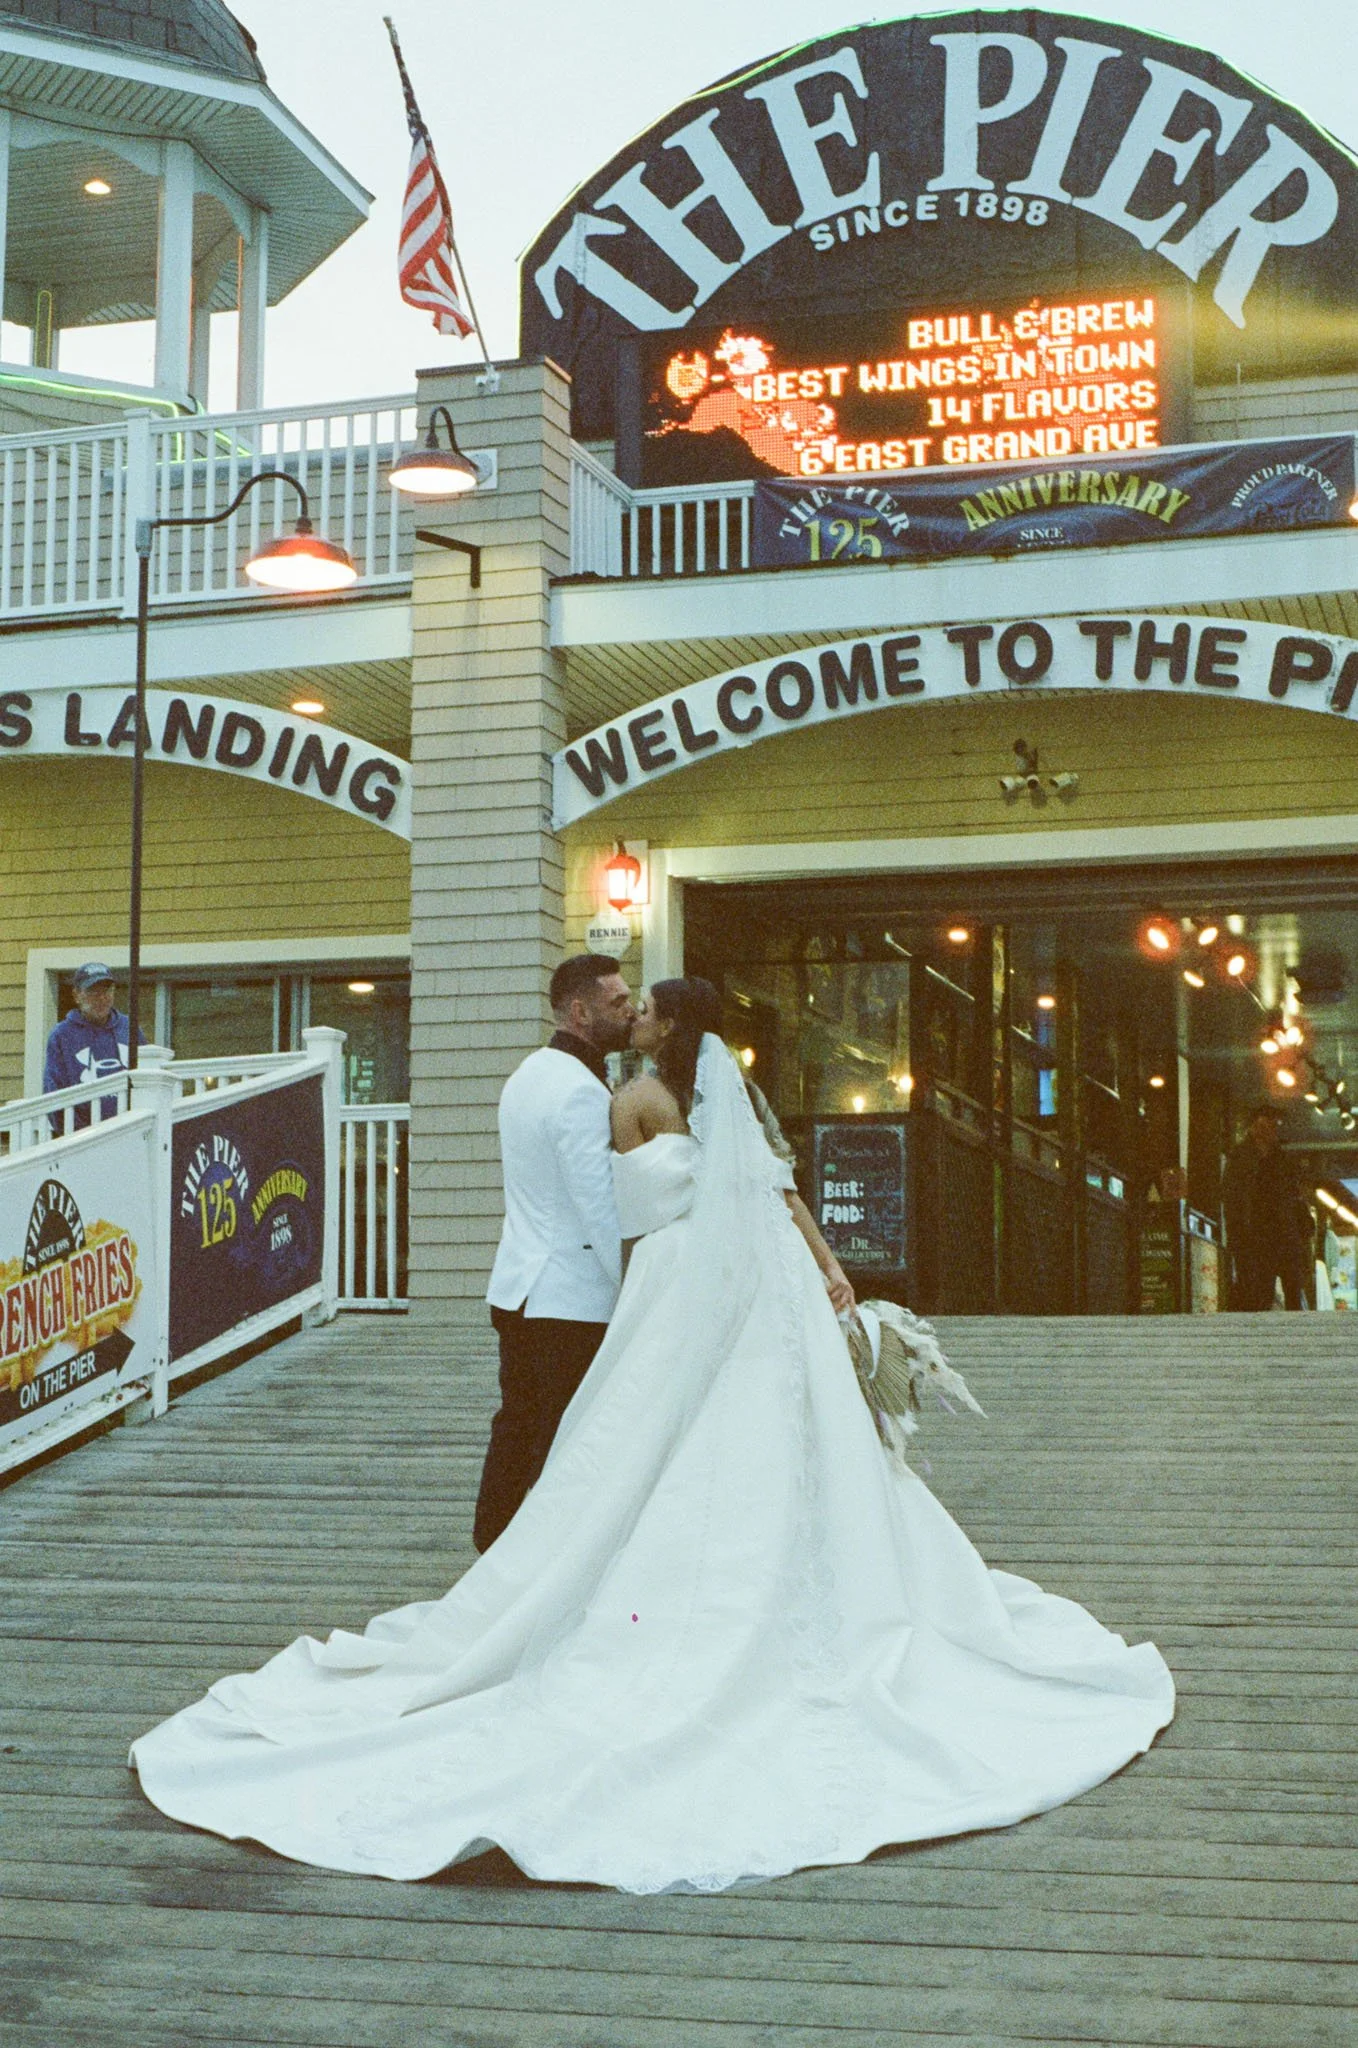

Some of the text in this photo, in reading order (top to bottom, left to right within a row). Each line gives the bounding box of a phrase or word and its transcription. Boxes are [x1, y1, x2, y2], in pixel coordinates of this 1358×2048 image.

[535, 32, 1338, 331] THE PIER
[809, 191, 1049, 251] SINCE 1898
[908, 299, 1154, 350] BULL & BREW
[753, 339, 1155, 402] BEST WINGS IN TOWN
[928, 380, 1156, 428] 14 FLAVORS
[801, 420, 1159, 476] 6 EAST GRAND AVE
[779, 486, 910, 538] THE PIER
[960, 470, 1191, 531] ANNIVERSARY
[1231, 463, 1338, 508] PROUD PARTNER
[804, 517, 883, 561] 125
[1020, 527, 1064, 542] SINCE
[565, 635, 925, 798] WELCOME
[948, 620, 1053, 685] TO
[1079, 619, 1248, 688] THE
[64, 692, 402, 821] LANDING
[181, 1134, 249, 1218] THE PIER
[251, 1169, 309, 1225] ANNIVERSARY
[823, 1180, 865, 1199] BEER:
[47, 1184, 84, 1251] PIER
[197, 1176, 237, 1248] 125
[821, 1203, 865, 1225] FOOD:
[70, 1235, 134, 1323] FRIES
[20, 1350, 96, 1409] ON THE PIER
